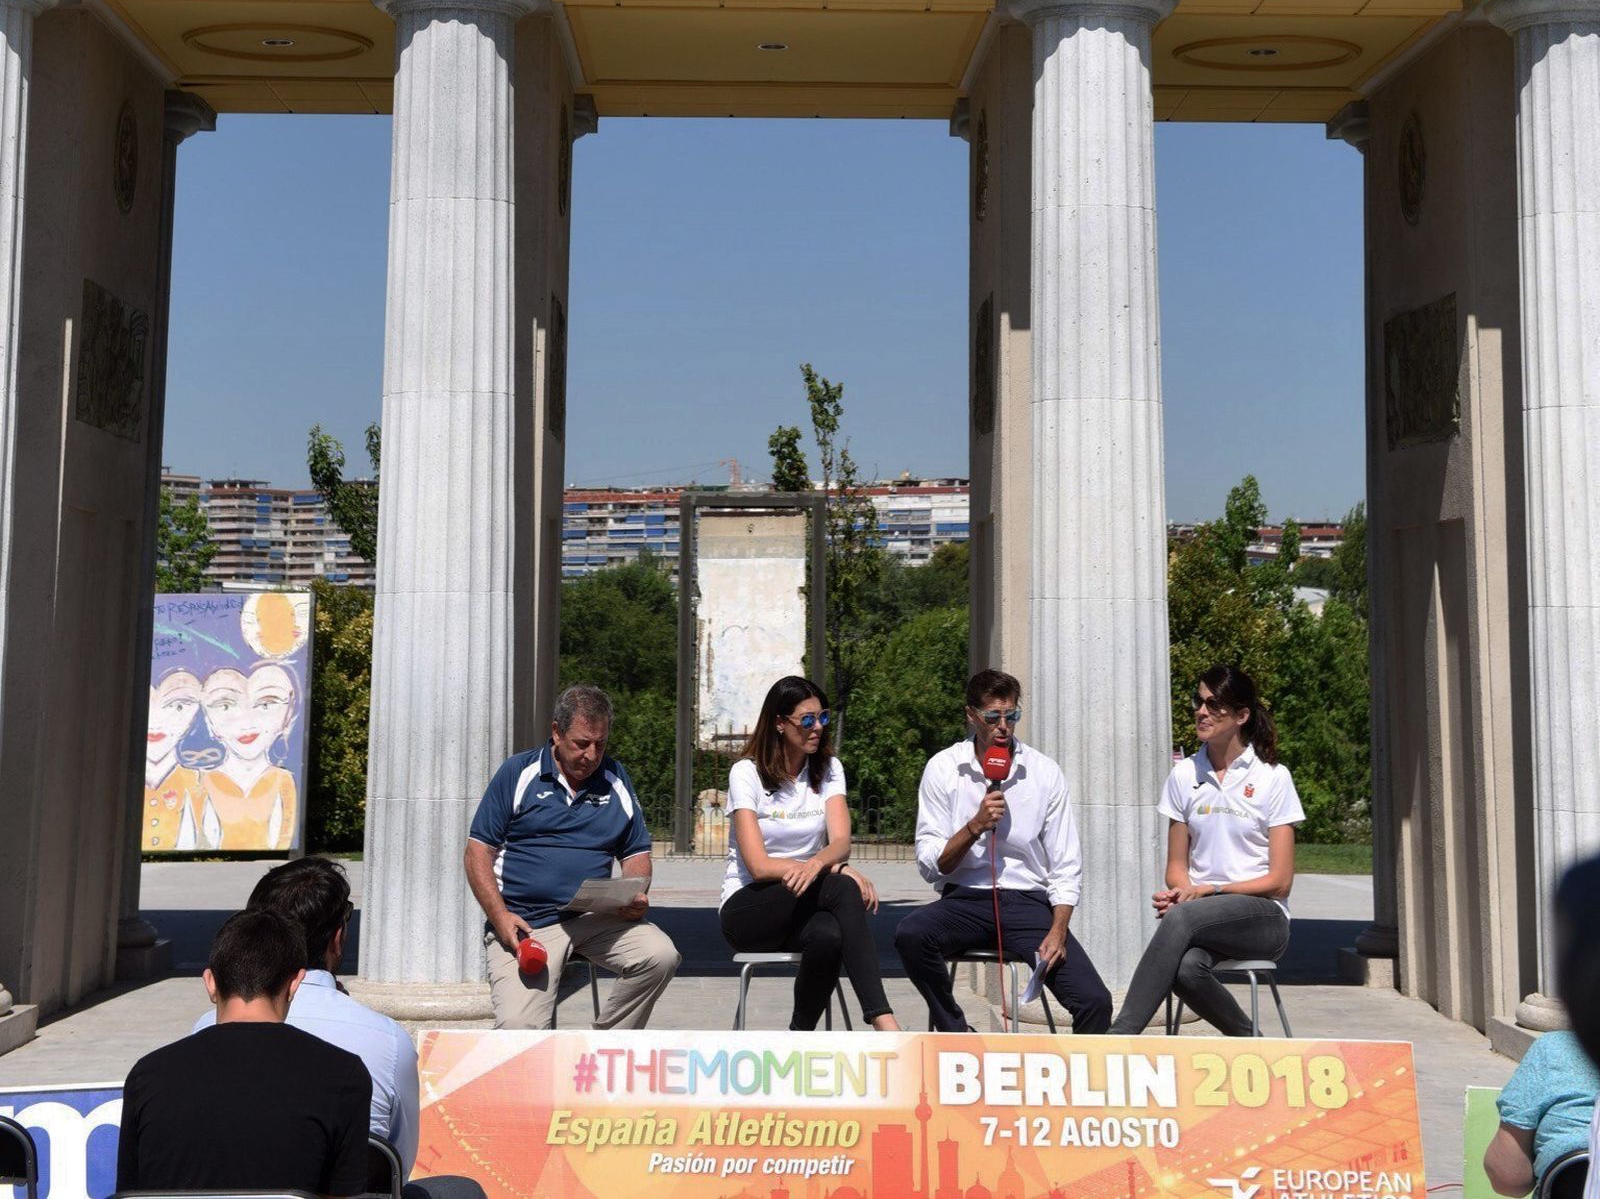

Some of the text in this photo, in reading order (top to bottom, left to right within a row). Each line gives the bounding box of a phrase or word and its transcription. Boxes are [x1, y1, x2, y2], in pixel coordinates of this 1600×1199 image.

[573, 1048, 898, 1097] #THEMOMENT
[938, 1051, 1349, 1110] BERLIN 2018
[546, 1110, 860, 1153] España Atletismo
[979, 1116, 1180, 1149] 7-12 AGOSTO
[648, 1152, 855, 1179] Pasión por competir
[1272, 1168, 1412, 1193] EUROPEAN
